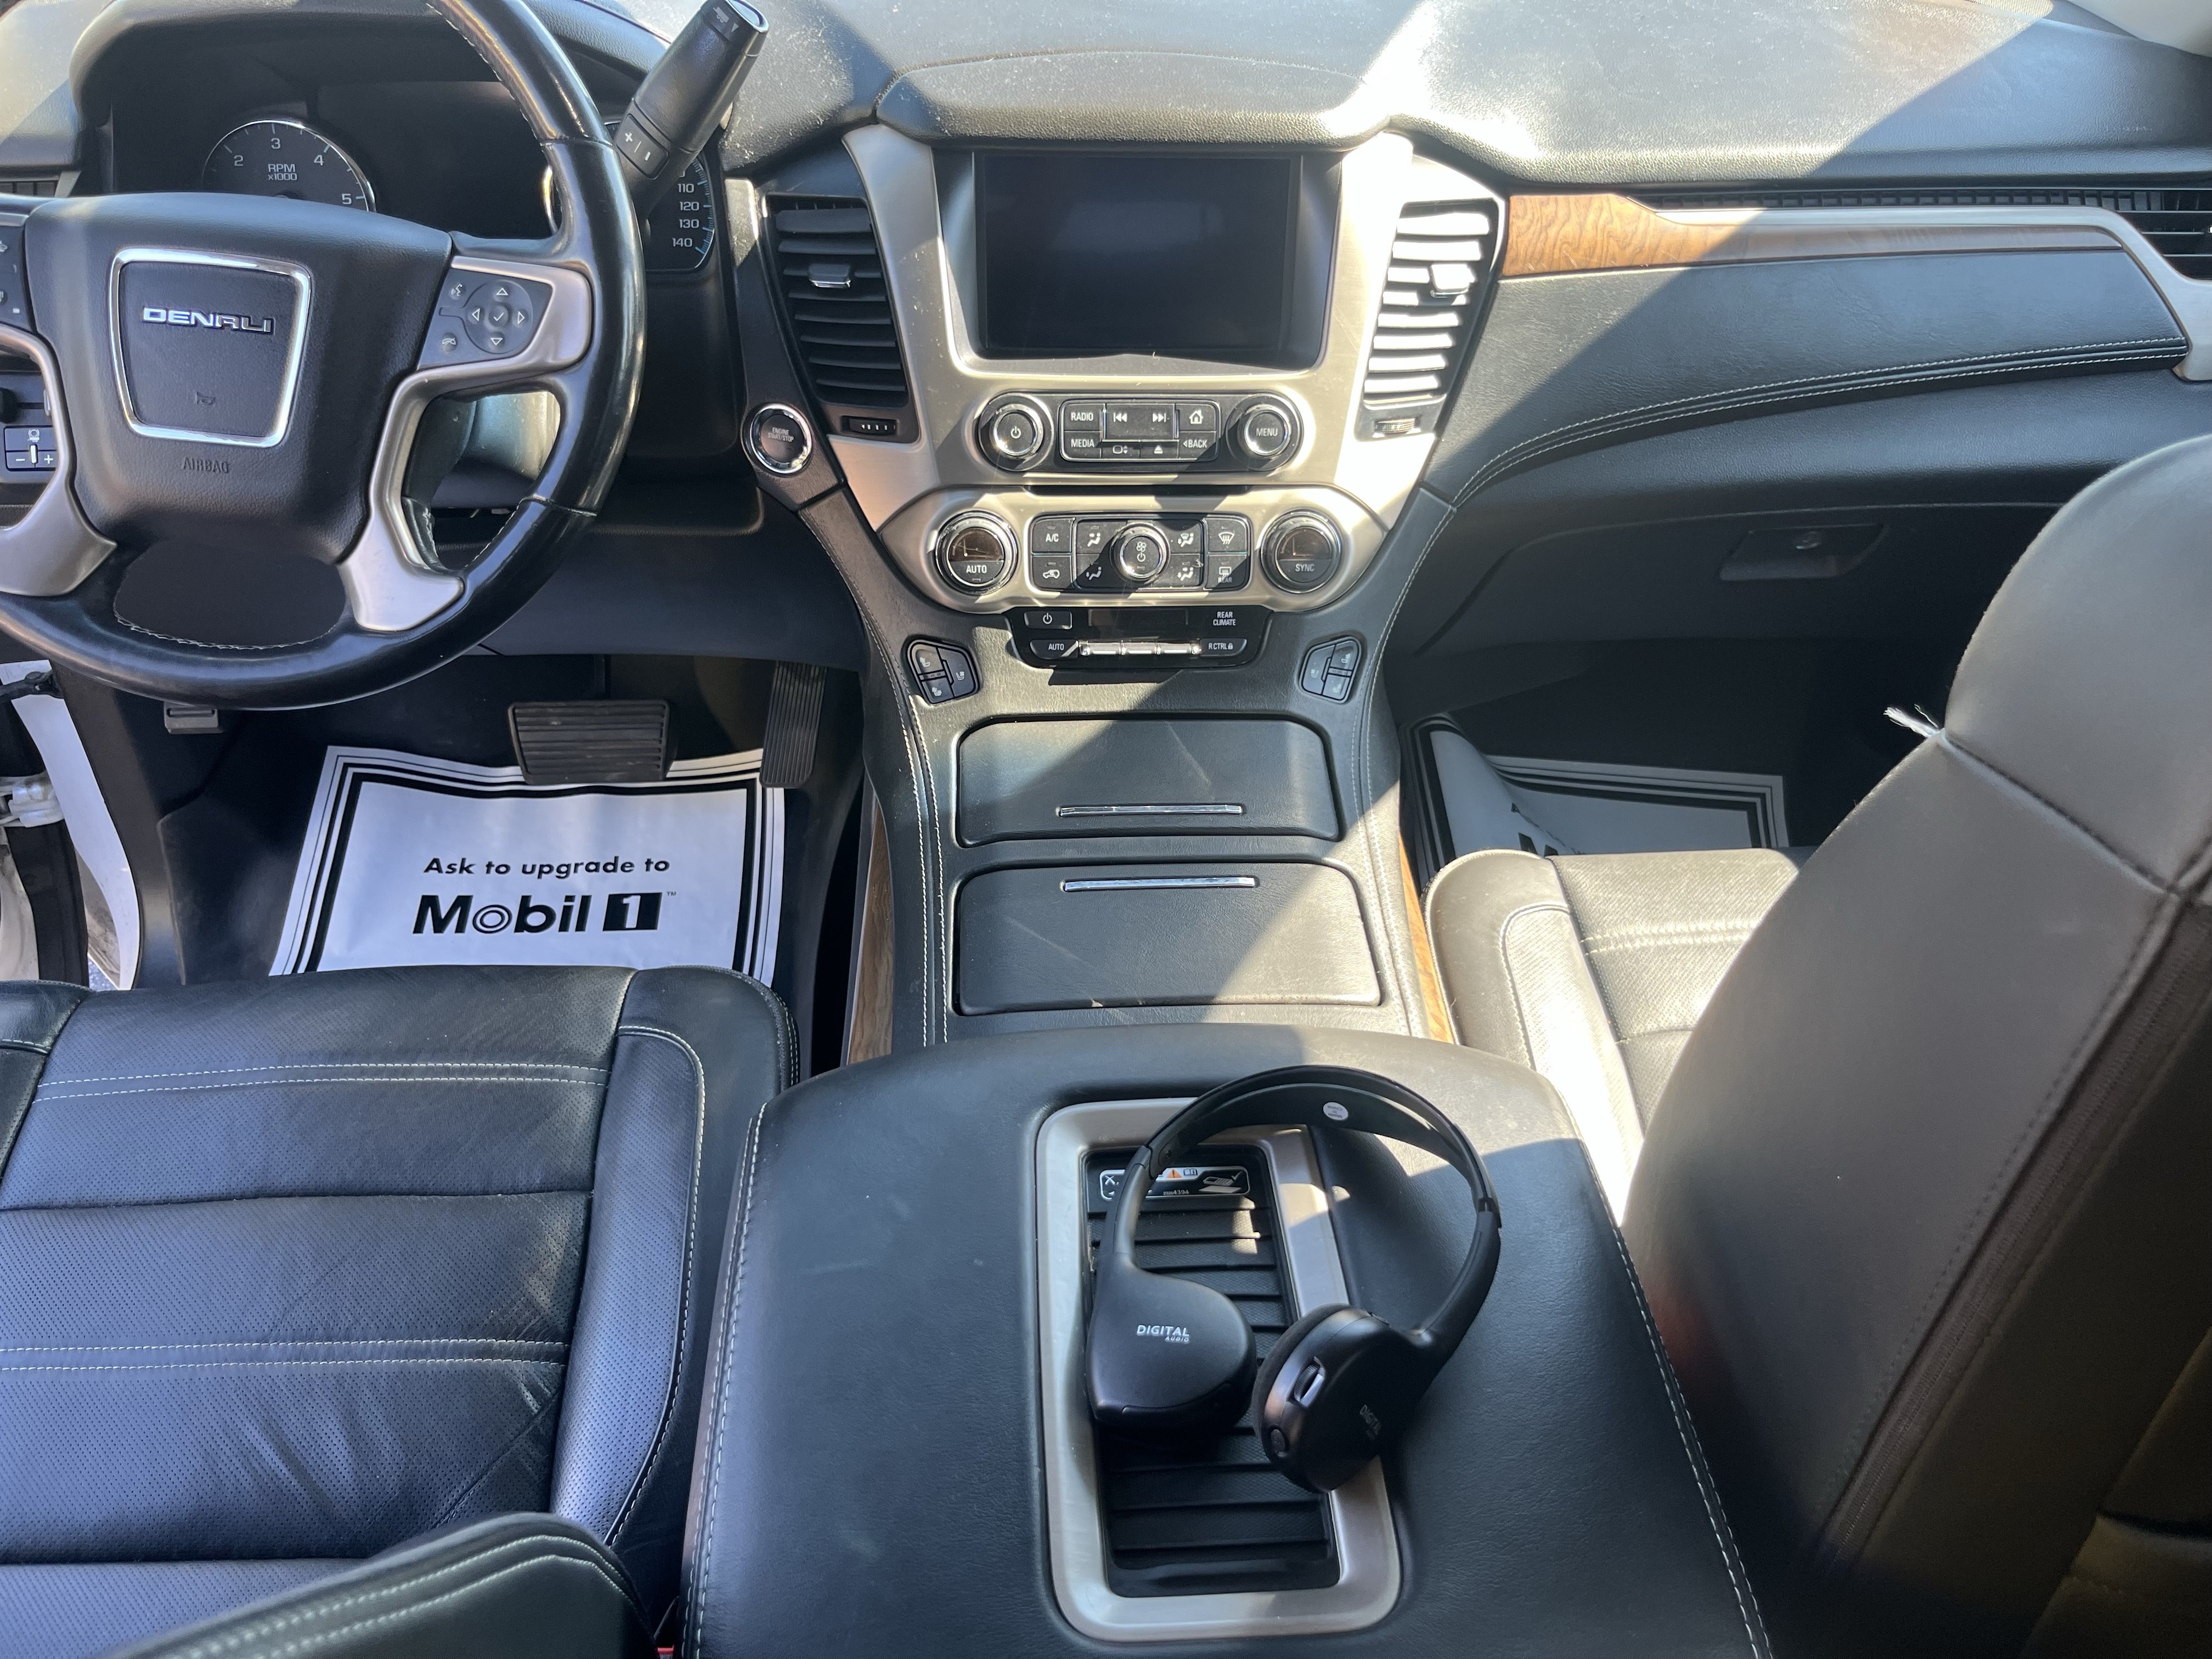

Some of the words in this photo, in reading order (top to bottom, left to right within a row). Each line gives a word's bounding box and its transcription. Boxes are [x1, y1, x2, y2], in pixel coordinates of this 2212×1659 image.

[271, 138, 281, 149] 3
[234, 155, 244, 166] 2
[314, 155, 324, 166] 4
[268, 163, 296, 173] RPM
[678, 183, 695, 193] 110
[342, 194, 352, 205] 5
[680, 201, 699, 211] 120
[679, 219, 699, 228] 130
[672, 238, 693, 247] 140
[143, 307, 272, 332] DENALI
[1070, 412, 1094, 422] RADIO
[772, 427, 789, 436] ENGINE
[1256, 427, 1278, 437] MENU
[768, 432, 794, 442] START/STOP
[1071, 438, 1095, 448] MEDIA
[1188, 439, 1207, 449] BACK
[180, 456, 229, 473] AIRBAG
[1045, 533, 1059, 543] A/C
[966, 565, 987, 574] AUTO
[1295, 563, 1315, 572] SYNC
[1048, 643, 1065, 651] AUTO
[423, 857, 476, 874] Ask
[486, 860, 511, 875] to
[521, 855, 635, 879] upgrade
[645, 857, 670, 872] to
[412, 894, 592, 935] Mobil
[1136, 1324, 1190, 1337] DIGITAL
